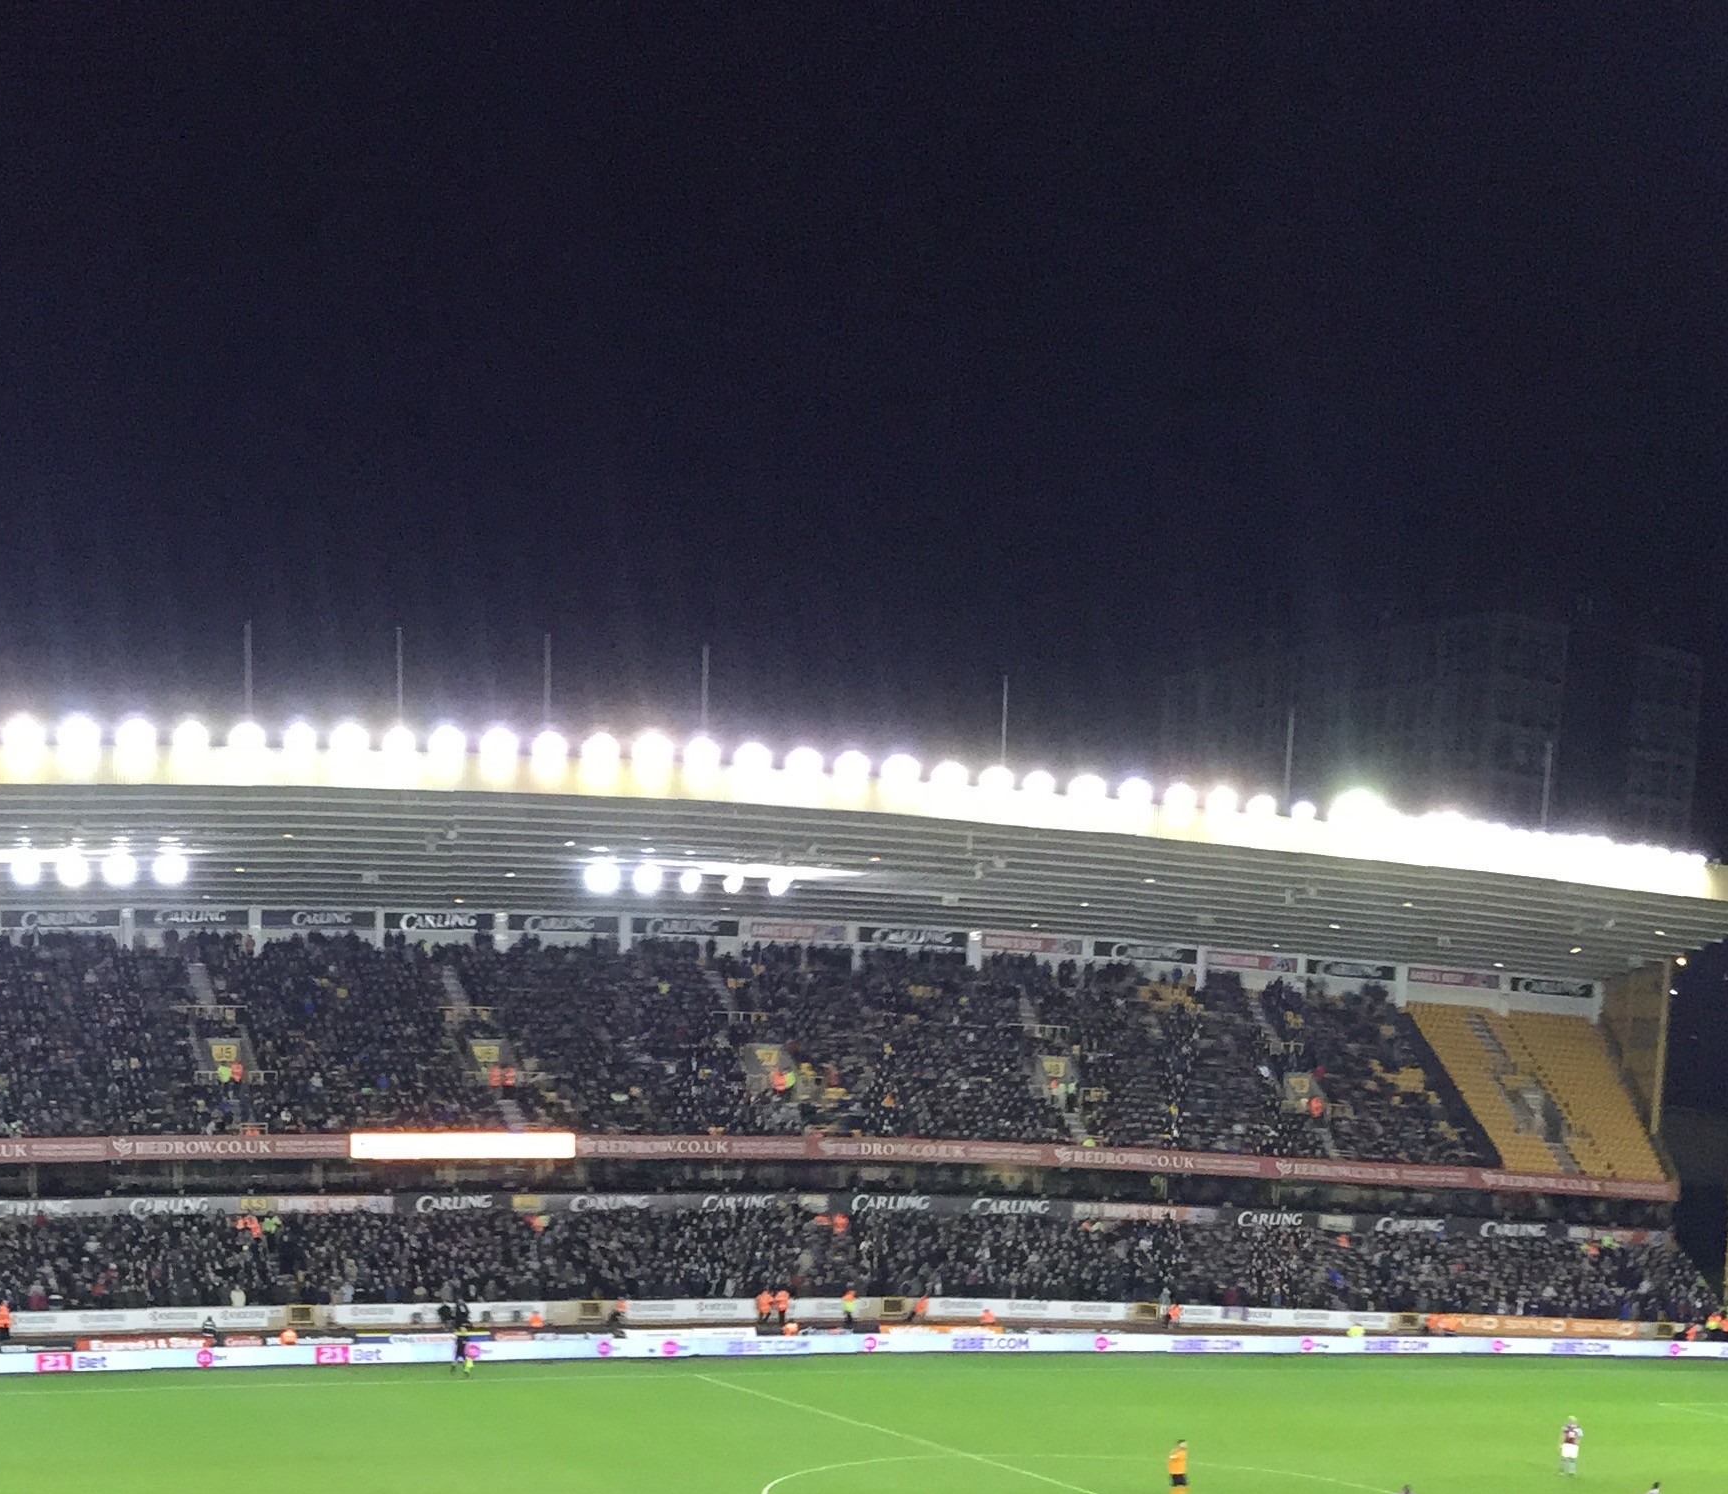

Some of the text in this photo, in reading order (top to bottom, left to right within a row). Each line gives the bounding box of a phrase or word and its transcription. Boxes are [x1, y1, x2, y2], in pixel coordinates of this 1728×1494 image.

[400, 912, 478, 930] CARLING
[134, 1138, 272, 1156] REDROW.CO.UK
[597, 1139, 729, 1155] REDROW.CO.UK
[1074, 1151, 1195, 1169] REDROW.CO.UK
[128, 1197, 210, 1221] CARLING
[415, 1194, 494, 1214] CARLING
[851, 1193, 932, 1212] CARLING
[971, 1197, 1051, 1216] CARLING
[1237, 1209, 1304, 1229] CARLING
